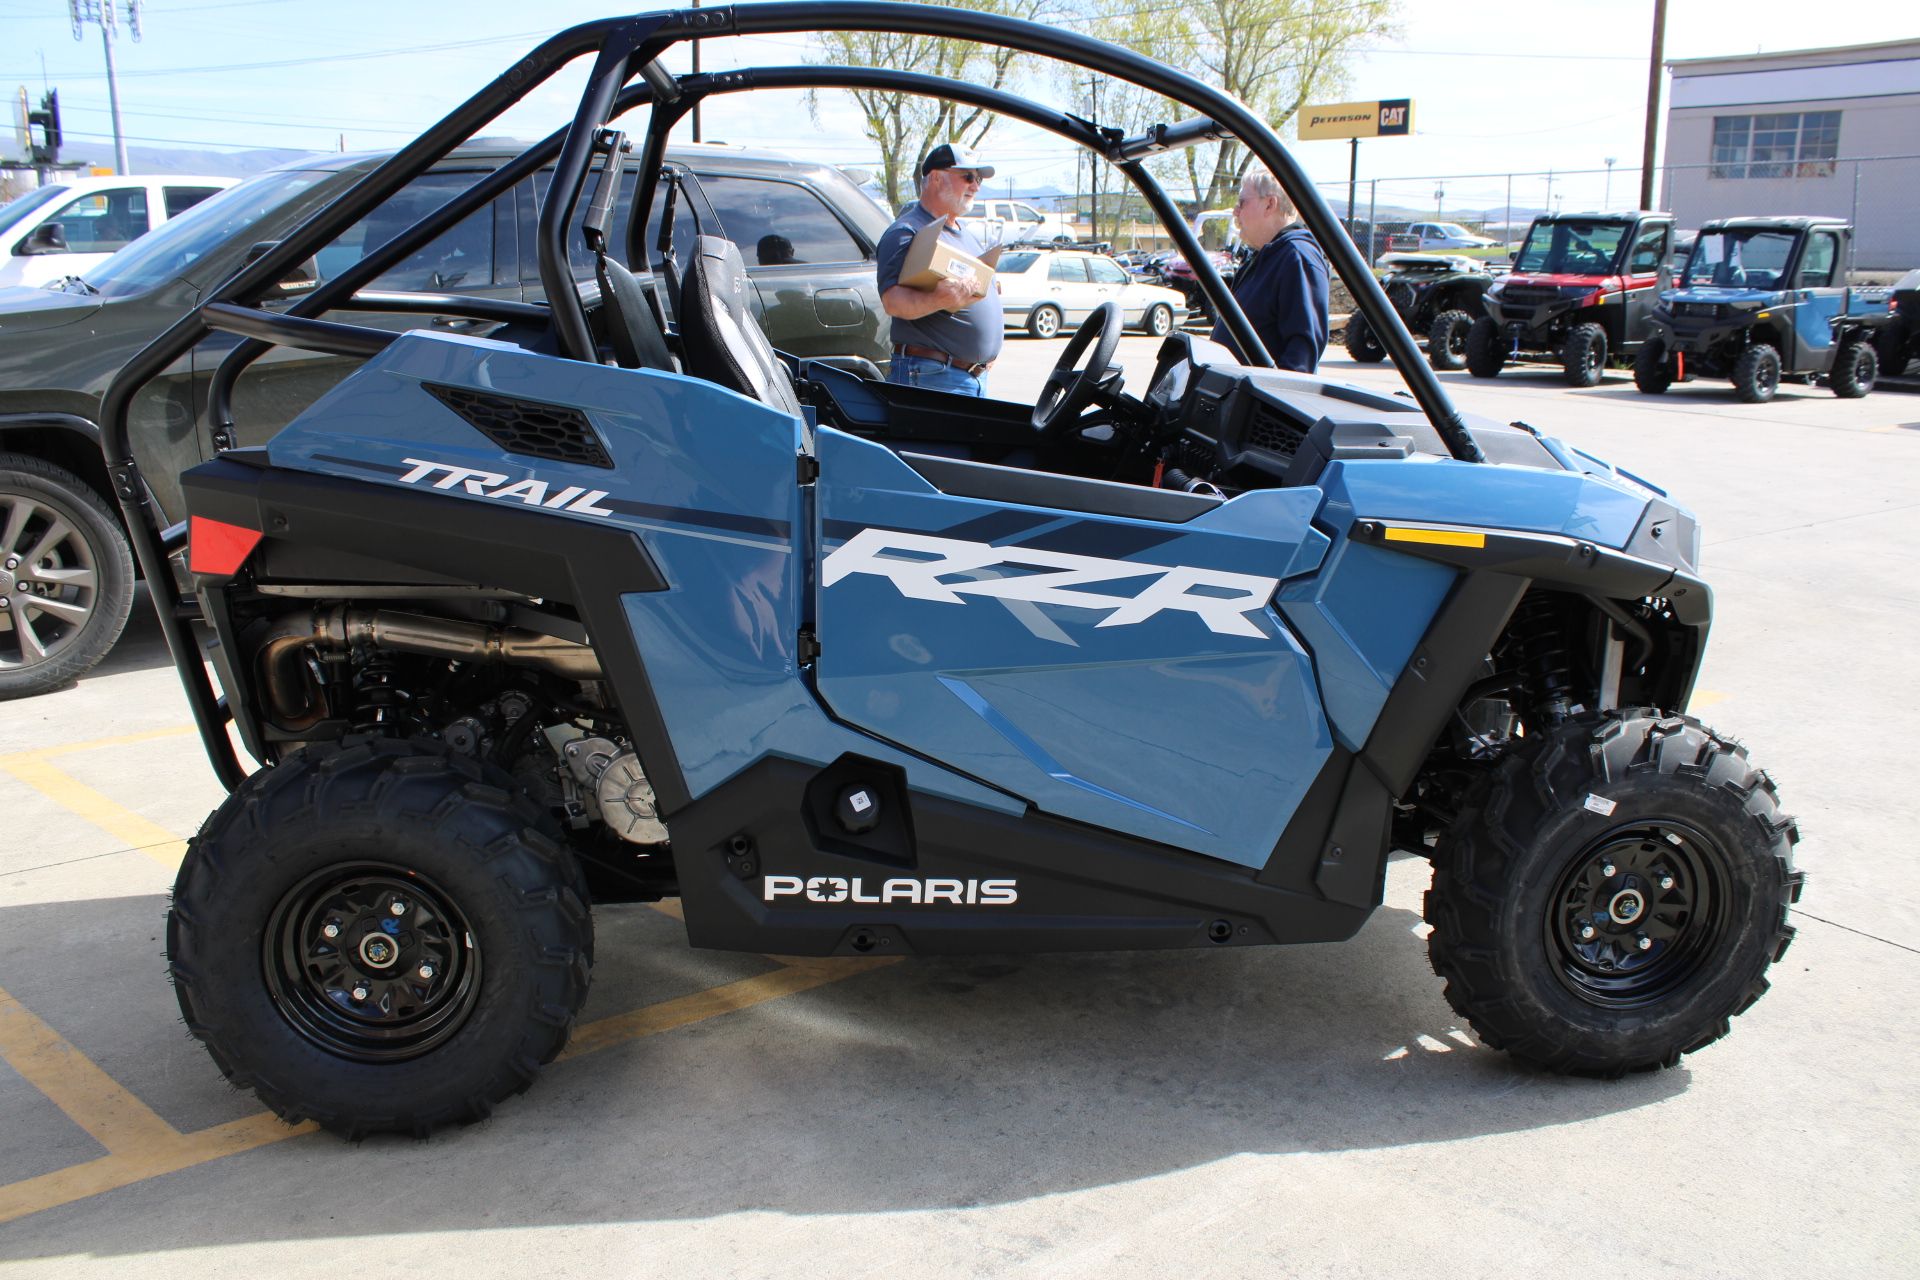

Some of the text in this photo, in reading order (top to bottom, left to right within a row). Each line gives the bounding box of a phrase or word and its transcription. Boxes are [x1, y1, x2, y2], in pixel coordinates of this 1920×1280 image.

[1310, 107, 1406, 128] PETERSON CAT
[398, 458, 614, 517] TRAIL
[822, 528, 1279, 640] RZR
[764, 875, 1018, 905] POLARIS
